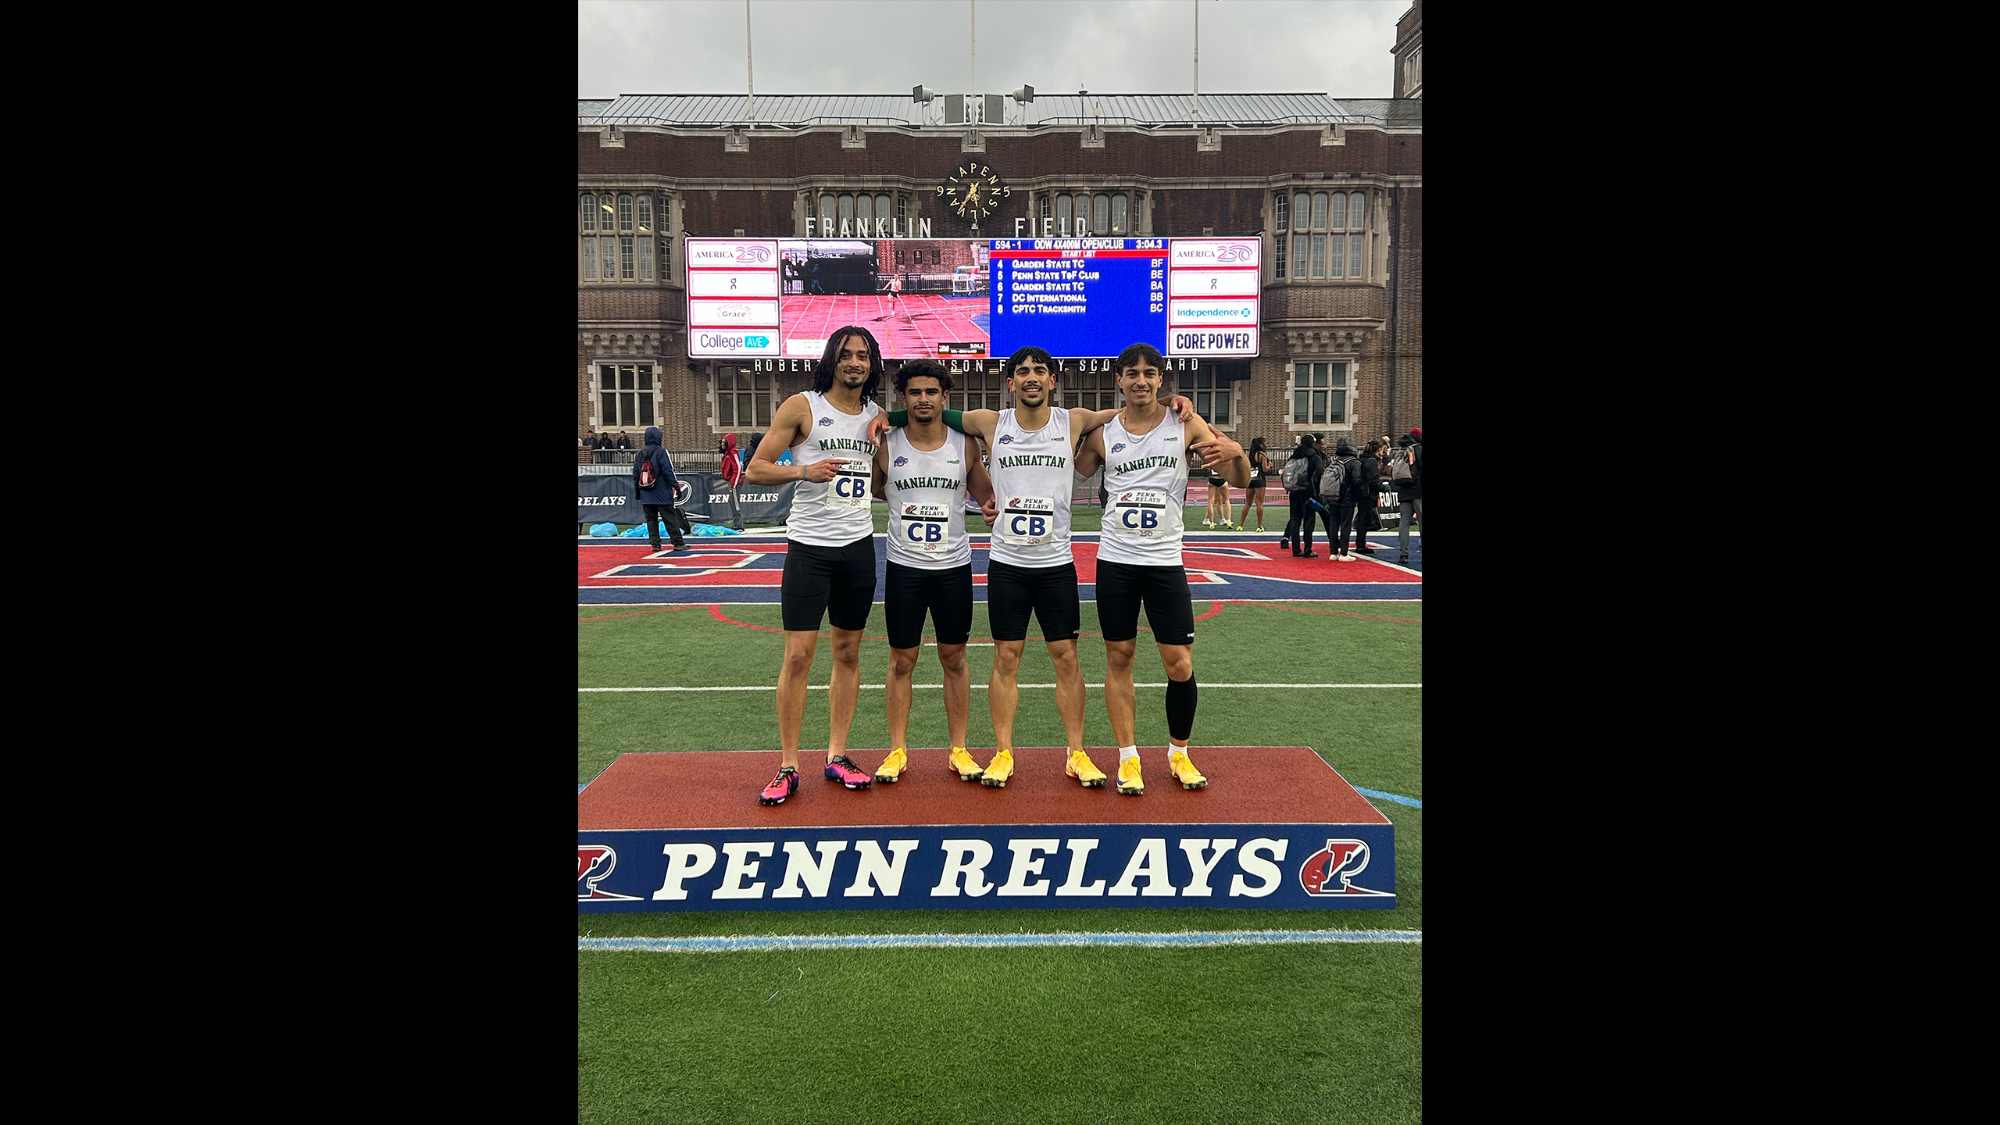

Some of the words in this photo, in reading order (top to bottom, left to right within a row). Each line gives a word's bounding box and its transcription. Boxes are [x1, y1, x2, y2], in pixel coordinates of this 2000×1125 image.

[937, 186, 944, 197] 9
[1003, 186, 1011, 198] 5
[805, 217, 931, 238] FRANKLIN
[1136, 240, 1163, 249] 3:04.3
[997, 260, 1003, 269] 4
[1151, 259, 1163, 268] BF
[997, 271, 1003, 280] 5
[1151, 270, 1163, 279] BE
[997, 282, 1003, 291] 6
[1150, 281, 1163, 290] BA
[997, 293, 1003, 302] 7
[1150, 292, 1163, 301] BB
[997, 304, 1003, 313] 8
[1150, 303, 1163, 312] BC
[1177, 308, 1239, 317] Independence
[700, 334, 743, 351] College
[747, 337, 763, 347] AVE
[1176, 333, 1206, 349] CORE
[1208, 333, 1250, 349] POWER
[998, 455, 1066, 468] MANHATTAN
[1114, 455, 1178, 476] MANHATTAN
[836, 477, 865, 497] CB
[894, 477, 960, 491] MANHATTAN
[740, 493, 779, 503] RELAYS
[1122, 509, 1158, 528] CB
[908, 522, 942, 542] CB
[1011, 516, 1046, 536] CB
[652, 839, 919, 901] PENN
[930, 838, 1289, 898] RELAYS
